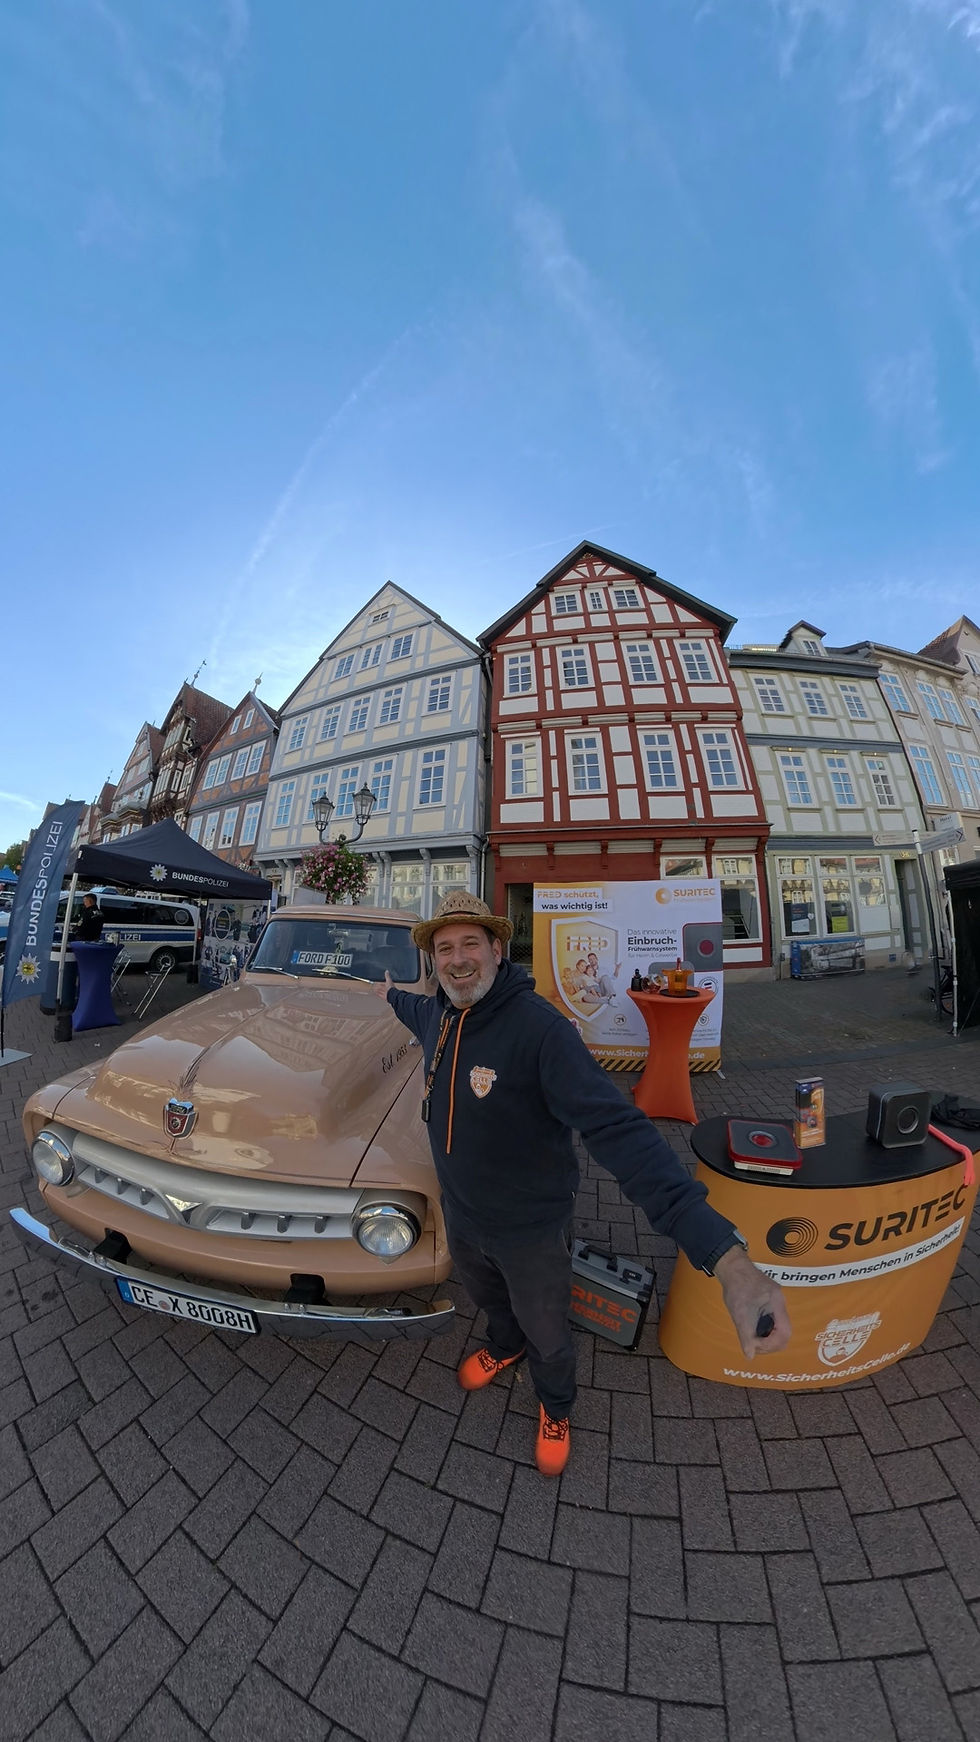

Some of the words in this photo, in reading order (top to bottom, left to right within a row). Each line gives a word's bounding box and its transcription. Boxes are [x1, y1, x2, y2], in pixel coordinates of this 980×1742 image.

[25, 820, 64, 947] BUNDESPOLIZEI
[171, 871, 230, 888] BUNDESPOLIZEI
[537, 891, 562, 899] FRED
[673, 888, 716, 897] SURITEC
[560, 901, 593, 911] wichtig
[594, 901, 608, 910] ist!
[105, 933, 141, 942] PLIZEI
[627, 936, 677, 945] Einbruch-
[299, 951, 323, 964] FORD
[325, 953, 350, 966] F100
[824, 1185, 967, 1251] SURITEC
[781, 1270, 836, 1283] bringen
[839, 1255, 902, 1279] Menschen
[903, 1251, 914, 1263] in
[131, 1285, 158, 1308] CE
[168, 1296, 183, 1315] X
[186, 1301, 252, 1330] 8008H
[571, 1285, 638, 1323] RITEC
[823, 1331, 870, 1347] CELLE
